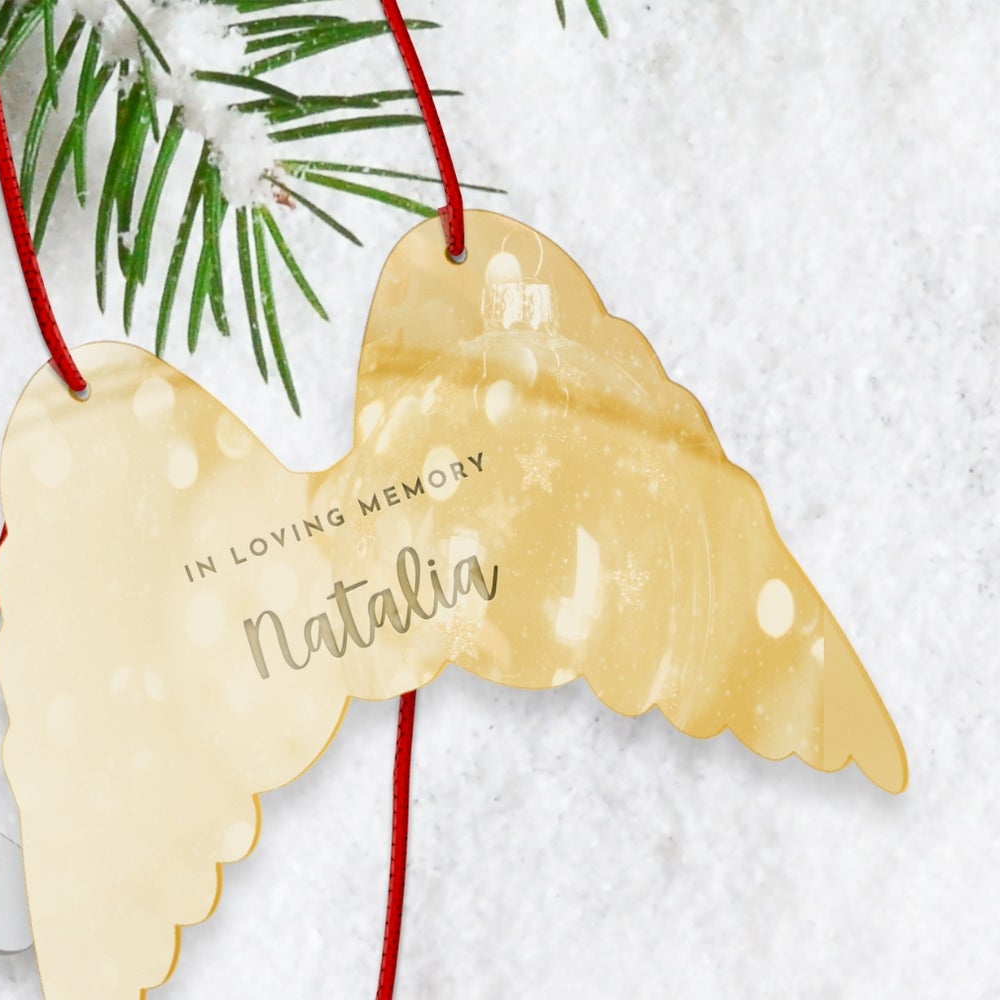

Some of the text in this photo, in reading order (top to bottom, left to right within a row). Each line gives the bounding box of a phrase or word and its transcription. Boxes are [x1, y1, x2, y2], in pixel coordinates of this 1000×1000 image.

[184, 452, 485, 582] IN LOVING MEMORY
[243, 546, 498, 679] Natalia
